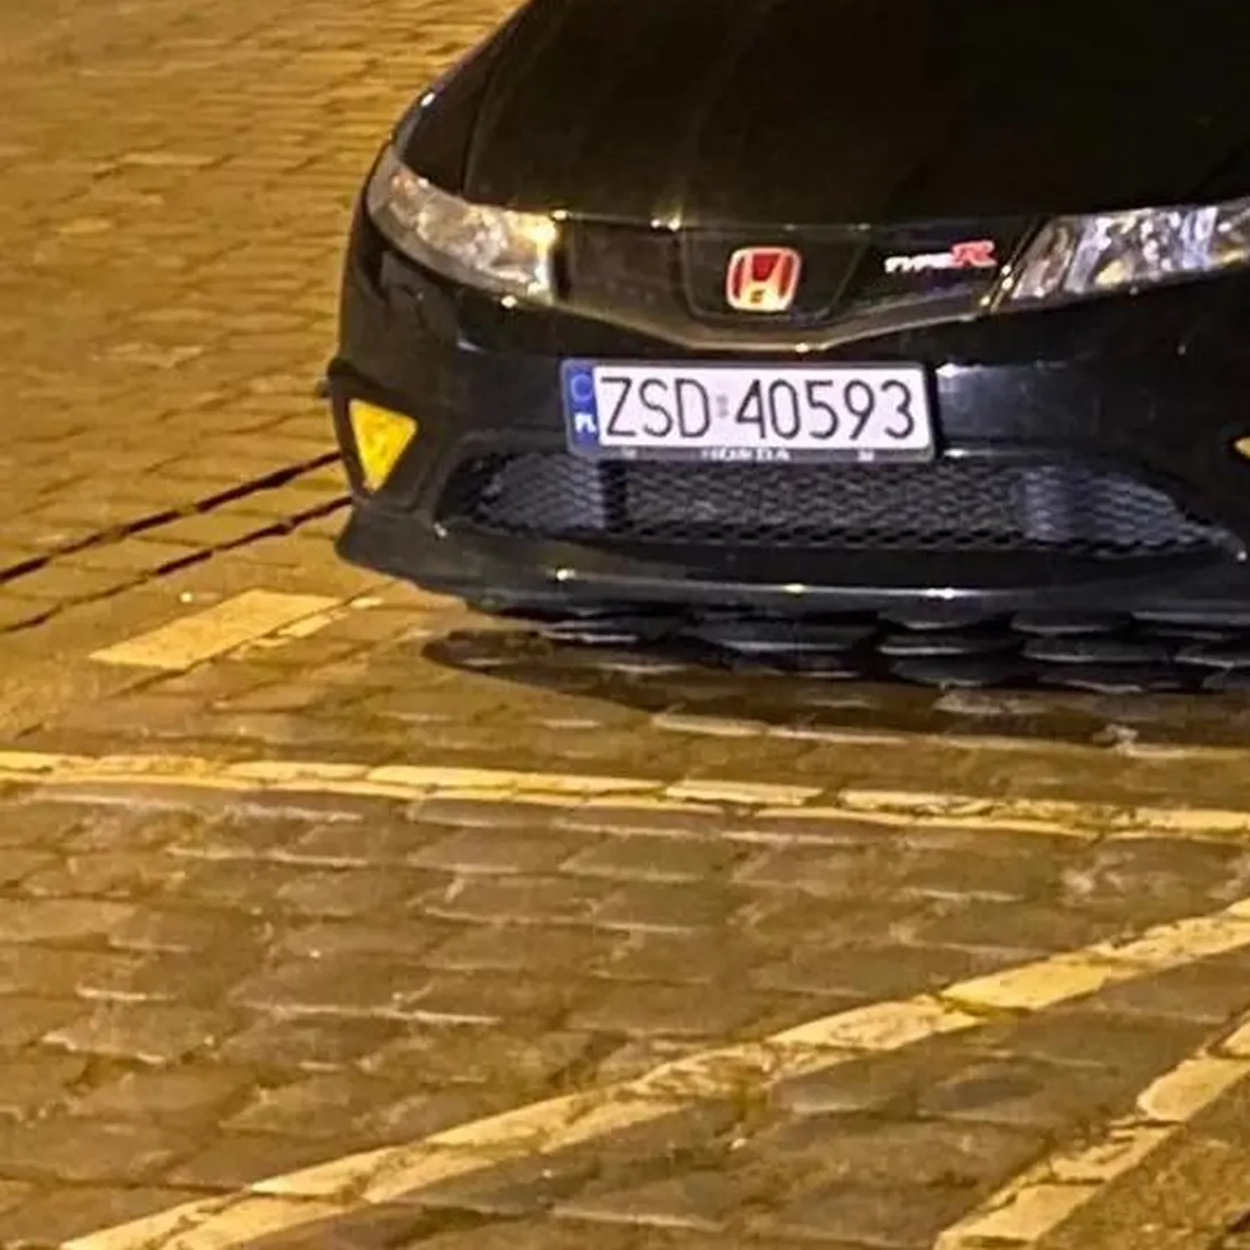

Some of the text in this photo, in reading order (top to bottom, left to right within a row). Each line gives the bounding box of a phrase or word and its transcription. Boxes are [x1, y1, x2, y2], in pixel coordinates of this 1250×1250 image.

[574, 412, 597, 434] PL
[600, 375, 916, 441] ZSD 40593
